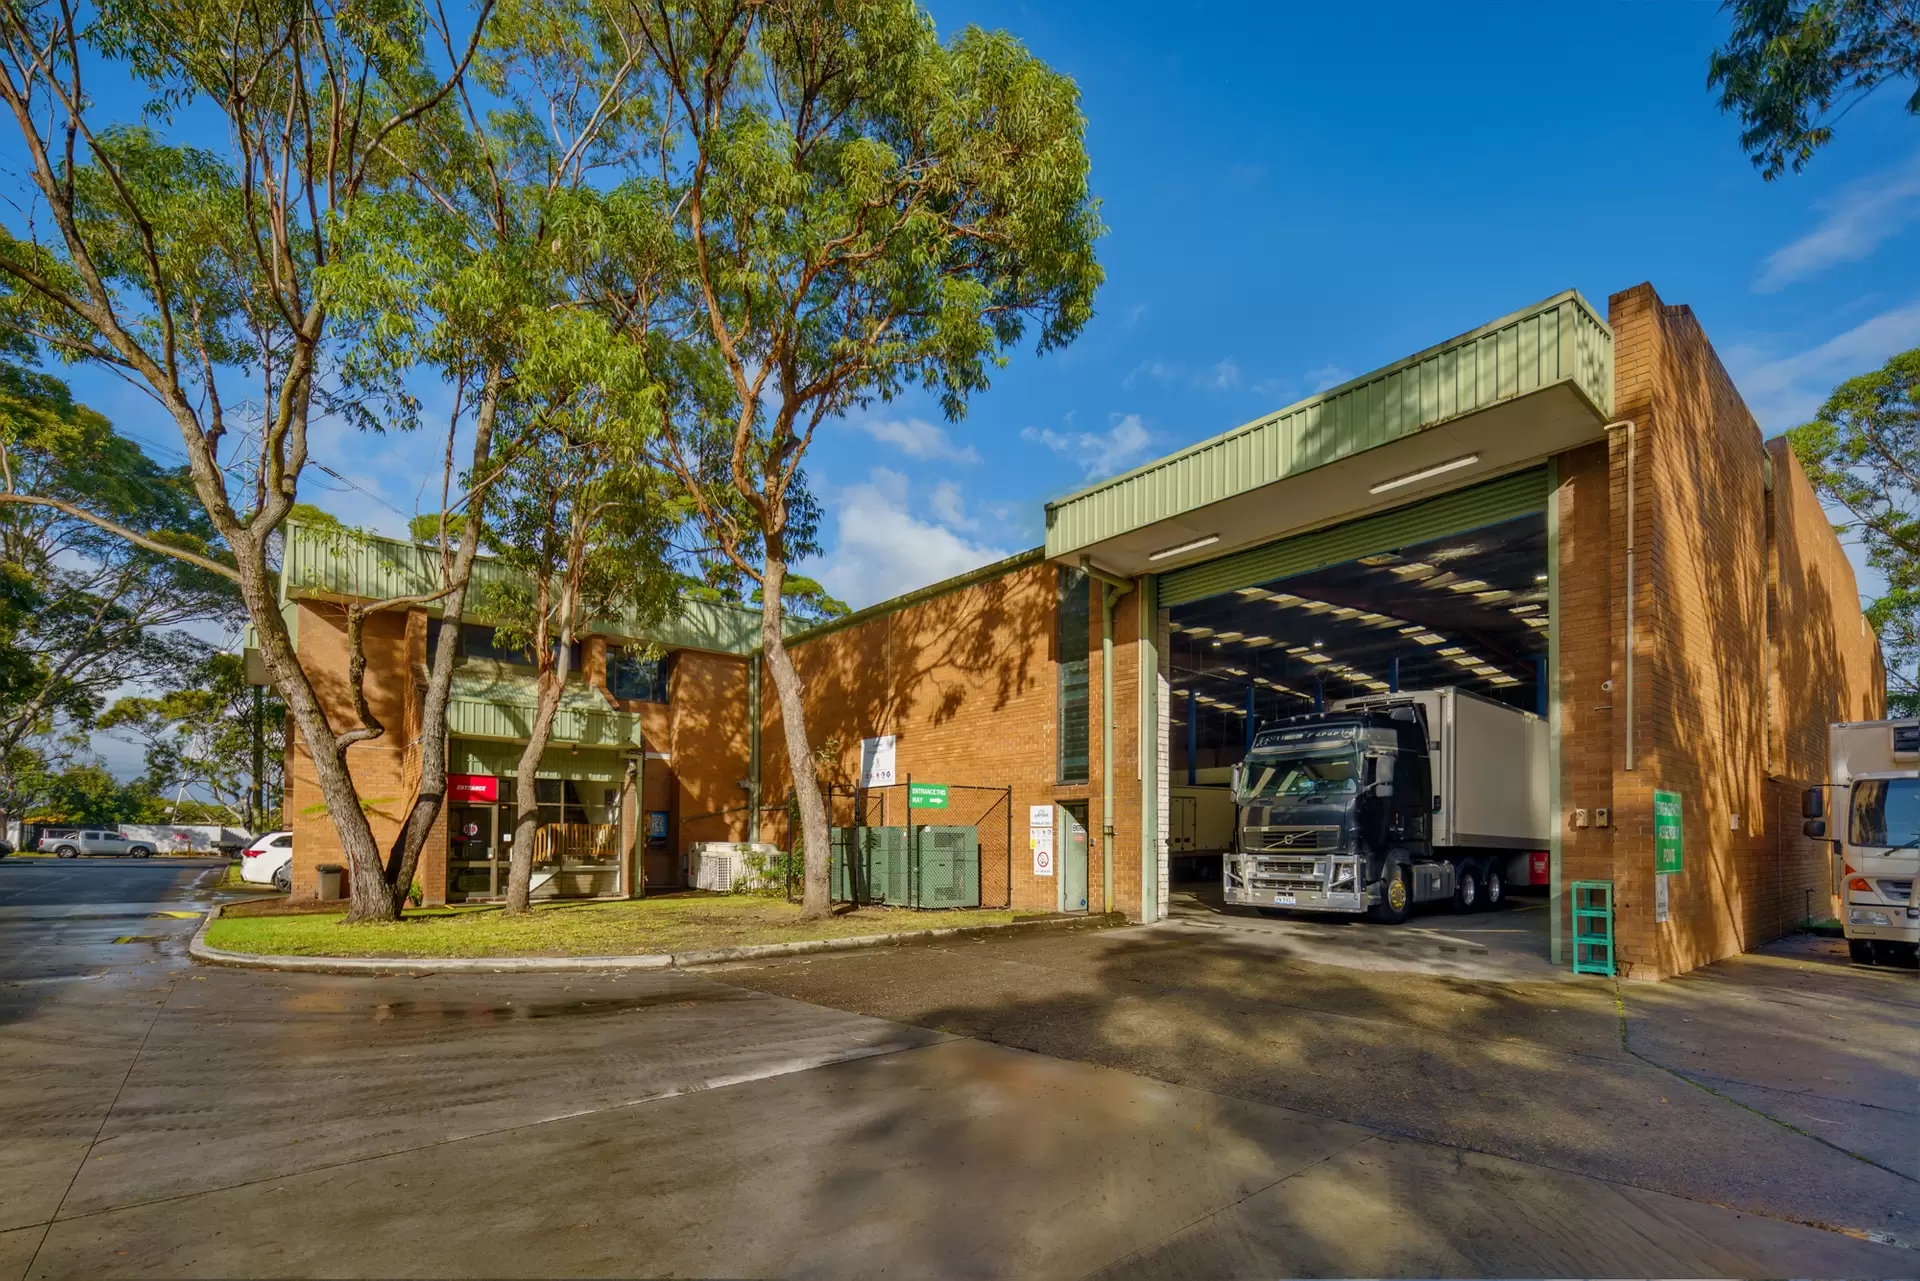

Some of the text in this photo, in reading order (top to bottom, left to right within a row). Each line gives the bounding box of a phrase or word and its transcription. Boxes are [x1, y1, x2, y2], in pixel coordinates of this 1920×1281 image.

[912, 787, 936, 796] ENTRANCE
[1656, 801, 1680, 816] EMERGENCY
[1659, 825, 1680, 840] ASSEMBLY
[1663, 848, 1675, 863] POINT
